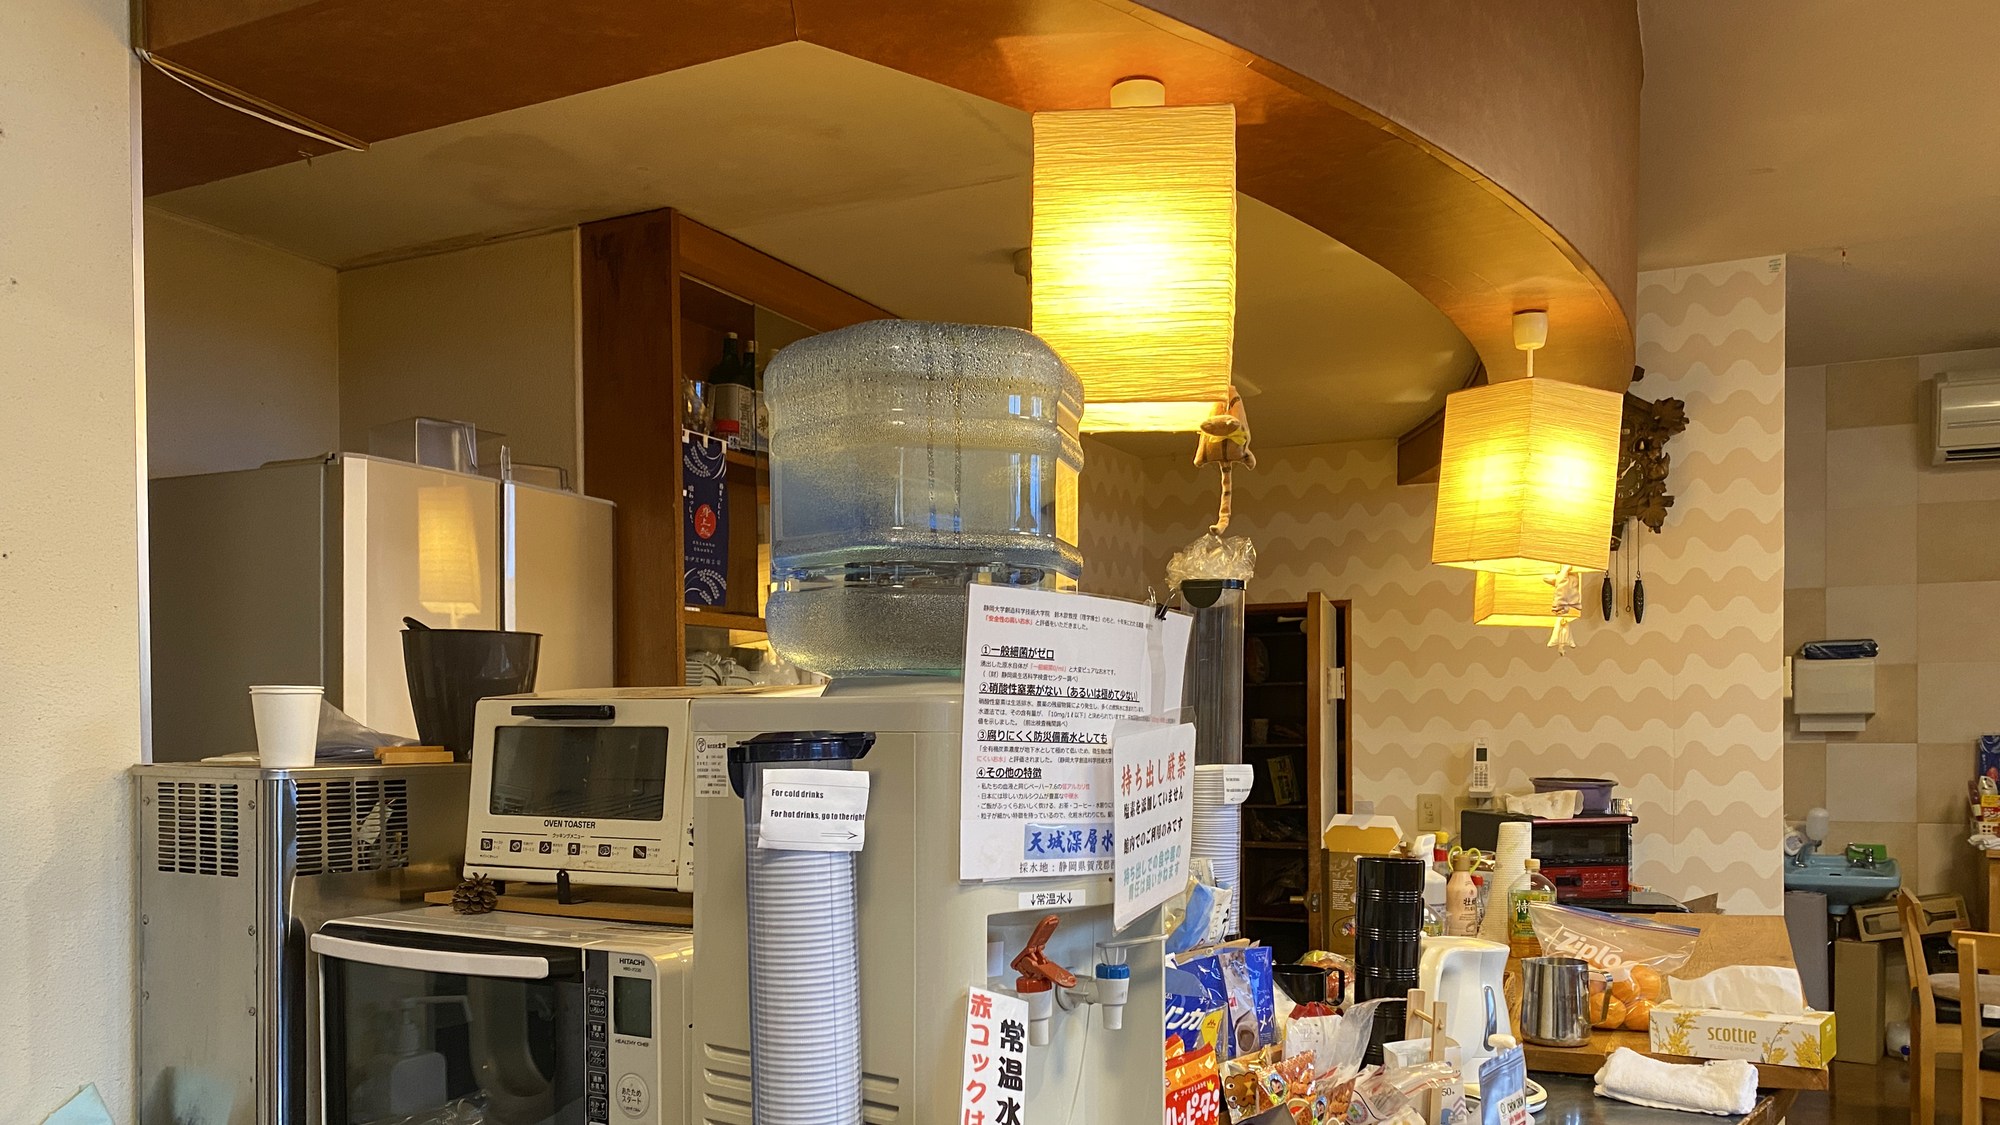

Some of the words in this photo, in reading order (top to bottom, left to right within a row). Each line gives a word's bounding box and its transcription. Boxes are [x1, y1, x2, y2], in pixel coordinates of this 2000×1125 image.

[975, 766, 1042, 778] ④その他の特徴
[771, 788, 783, 797] For
[784, 789, 800, 798] cold
[801, 789, 824, 799] drinks
[770, 809, 782, 817] For
[783, 810, 796, 818] hot
[821, 812, 831, 821] go
[839, 812, 850, 820] the
[543, 819, 563, 828] OVEN
[563, 820, 596, 829] TOASTER
[1027, 828, 1114, 854] 天城深層水
[1036, 892, 1067, 906] 常温水
[618, 957, 645, 967] HITACHI
[621, 1087, 642, 1097] あたため
[621, 1096, 642, 1105] スタート
